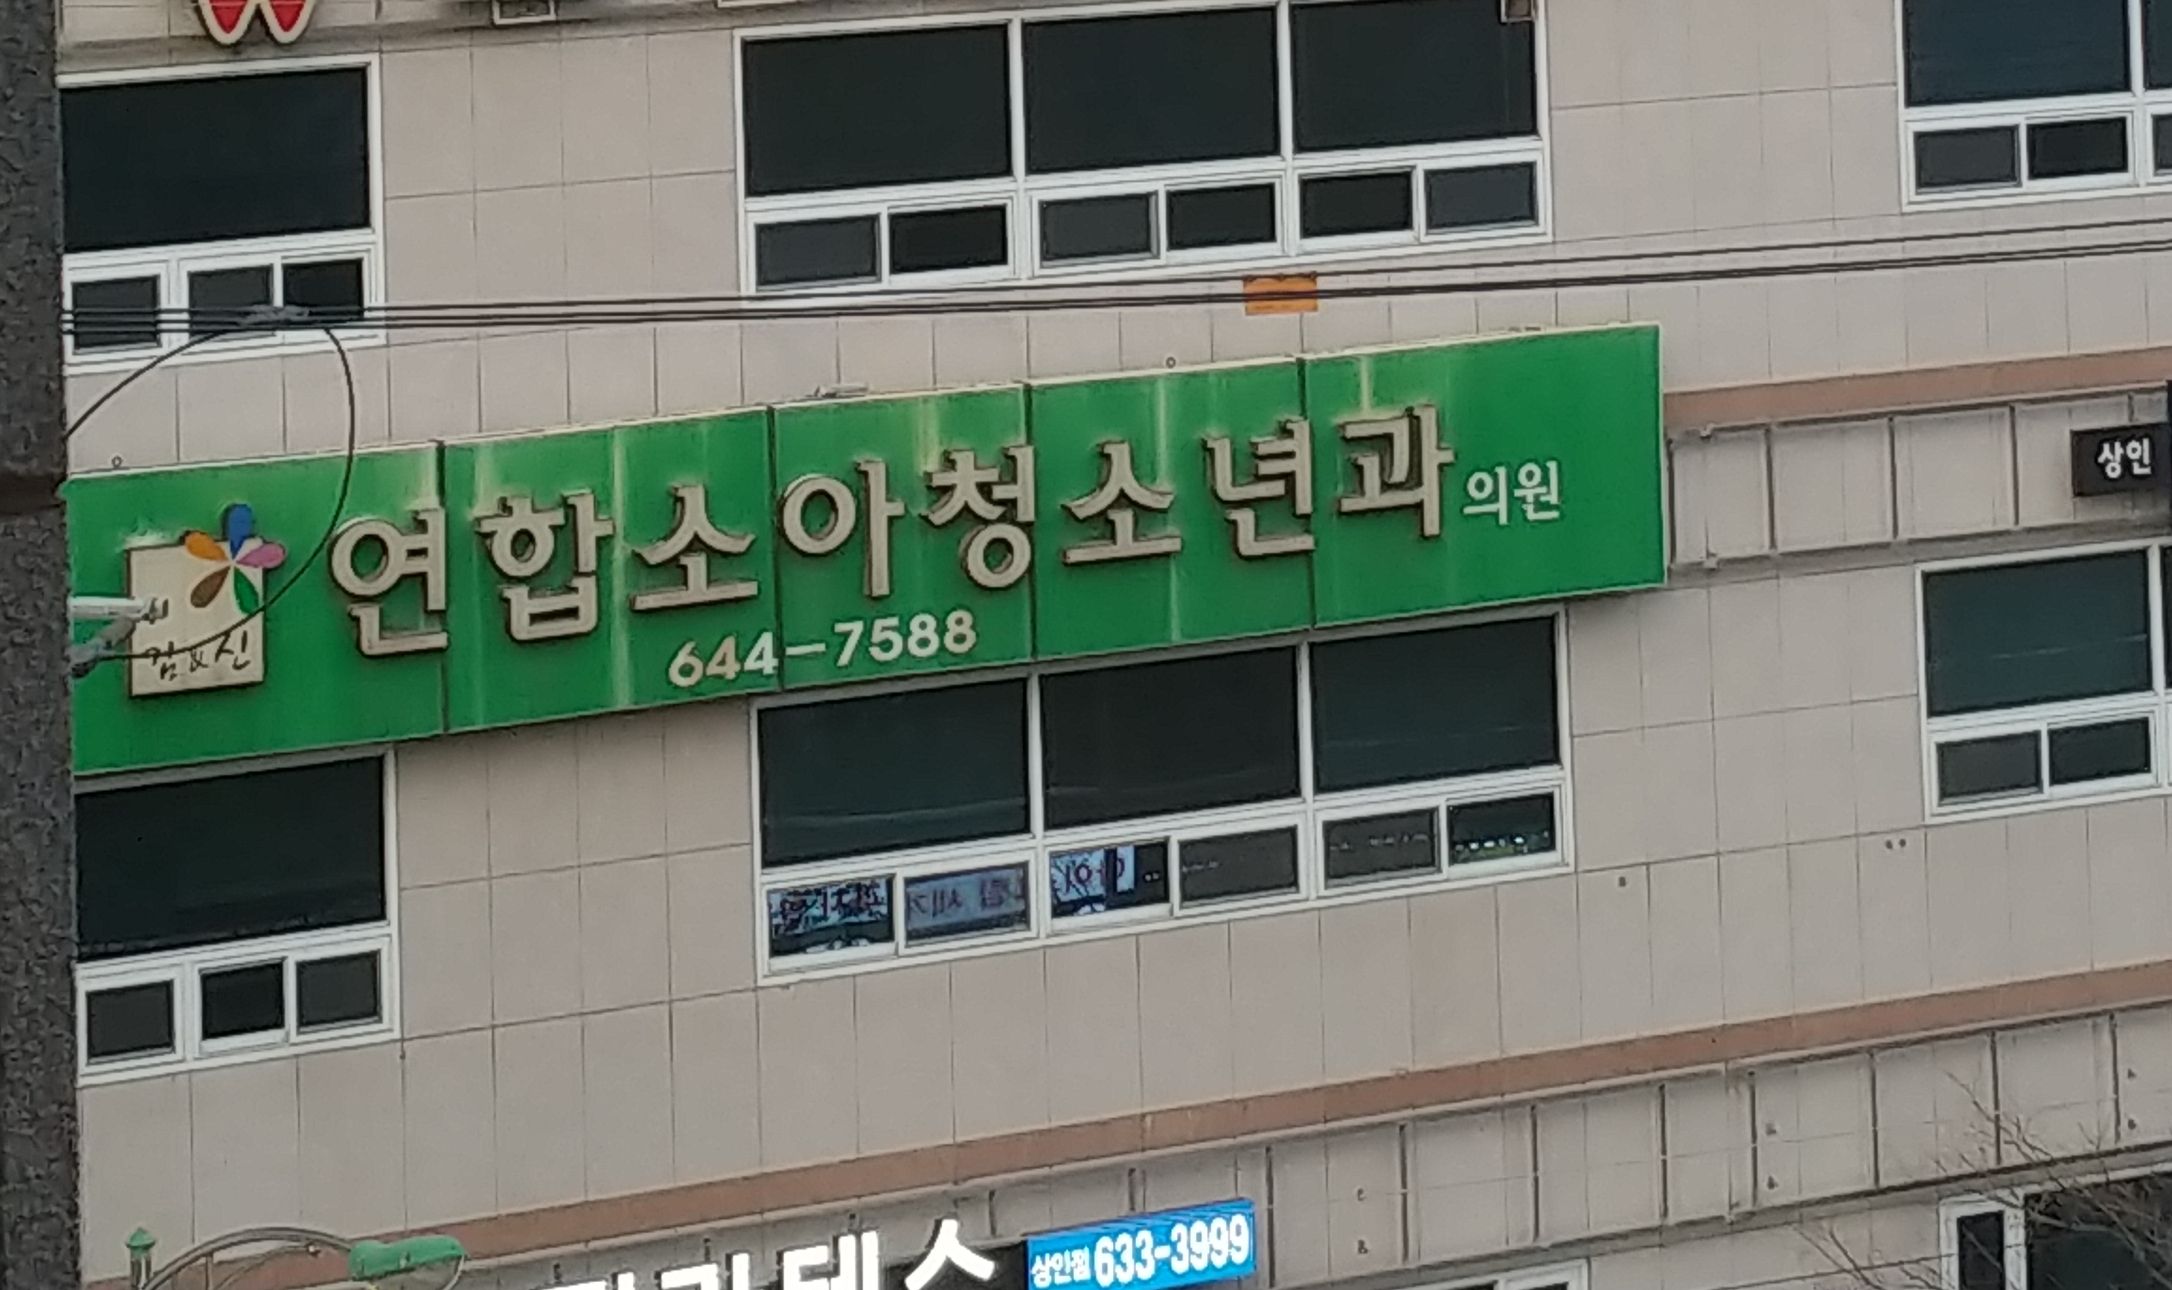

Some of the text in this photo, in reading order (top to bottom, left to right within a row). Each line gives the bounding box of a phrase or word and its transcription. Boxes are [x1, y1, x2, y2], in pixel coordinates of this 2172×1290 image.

[2097, 437, 2152, 479] 상인
[329, 404, 1560, 658] 연합소아청소년과 의원
[668, 609, 977, 688] 644-7588
[1031, 1213, 1249, 1288] 상인점 633-3999
